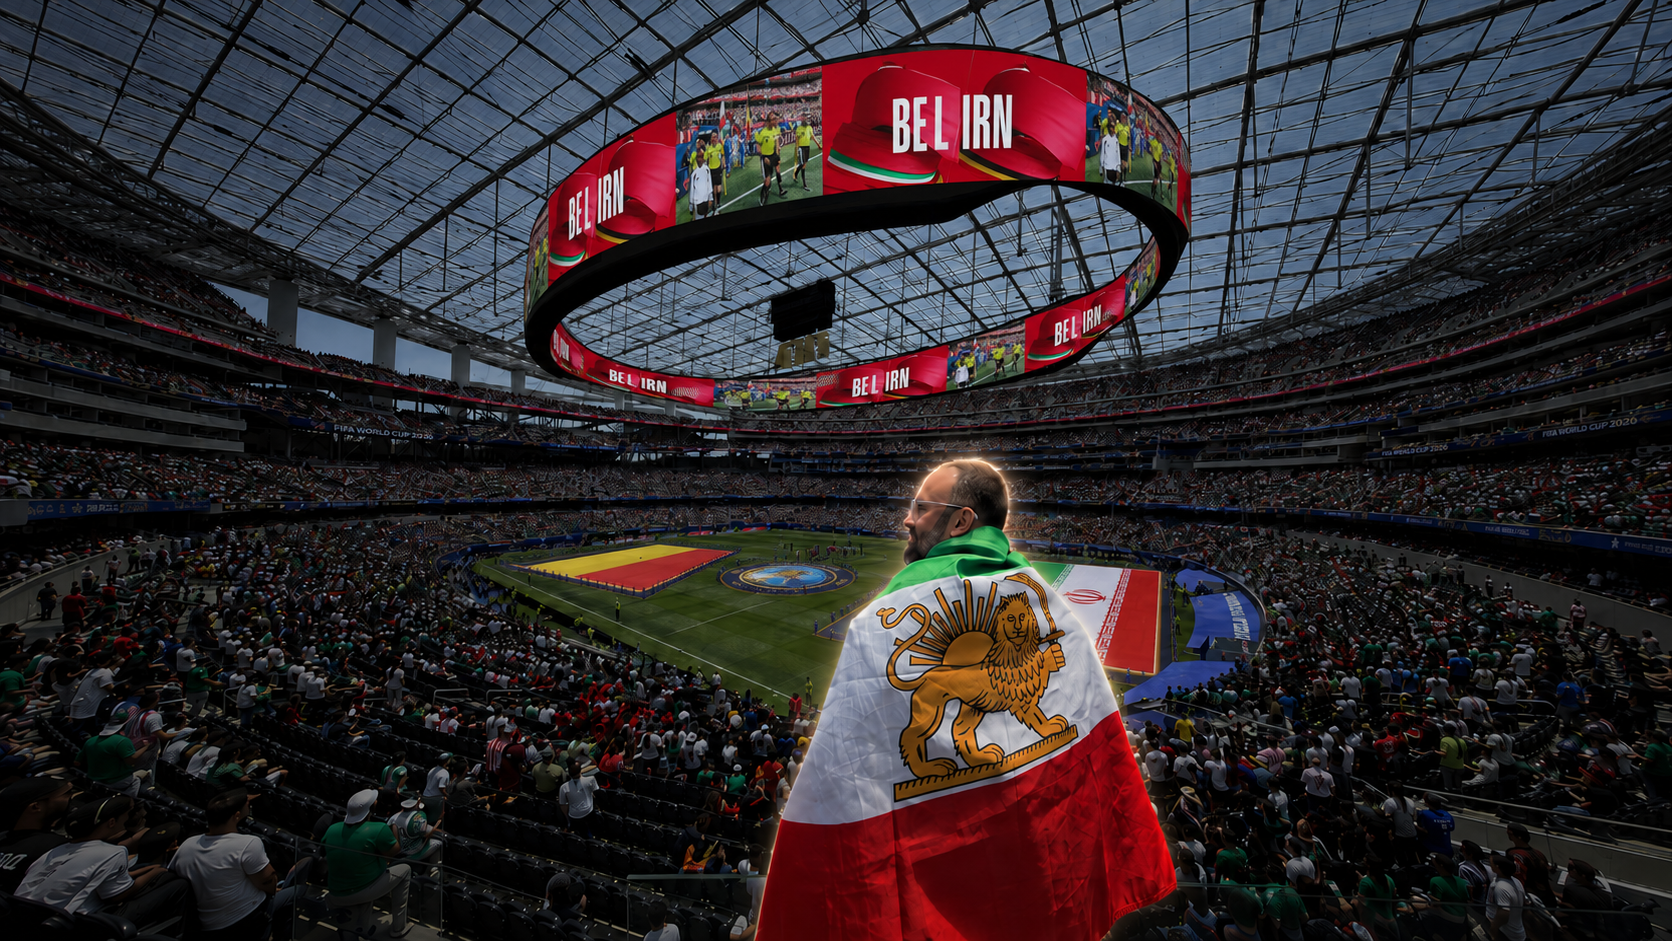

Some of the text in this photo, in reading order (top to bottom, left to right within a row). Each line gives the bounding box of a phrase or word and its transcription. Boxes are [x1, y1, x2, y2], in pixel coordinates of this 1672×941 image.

[962, 94, 1013, 149] IRN
[597, 166, 625, 224] IRN
[1082, 304, 1102, 334] IRN
[640, 377, 668, 394] IRN
[885, 367, 910, 392] IRN
